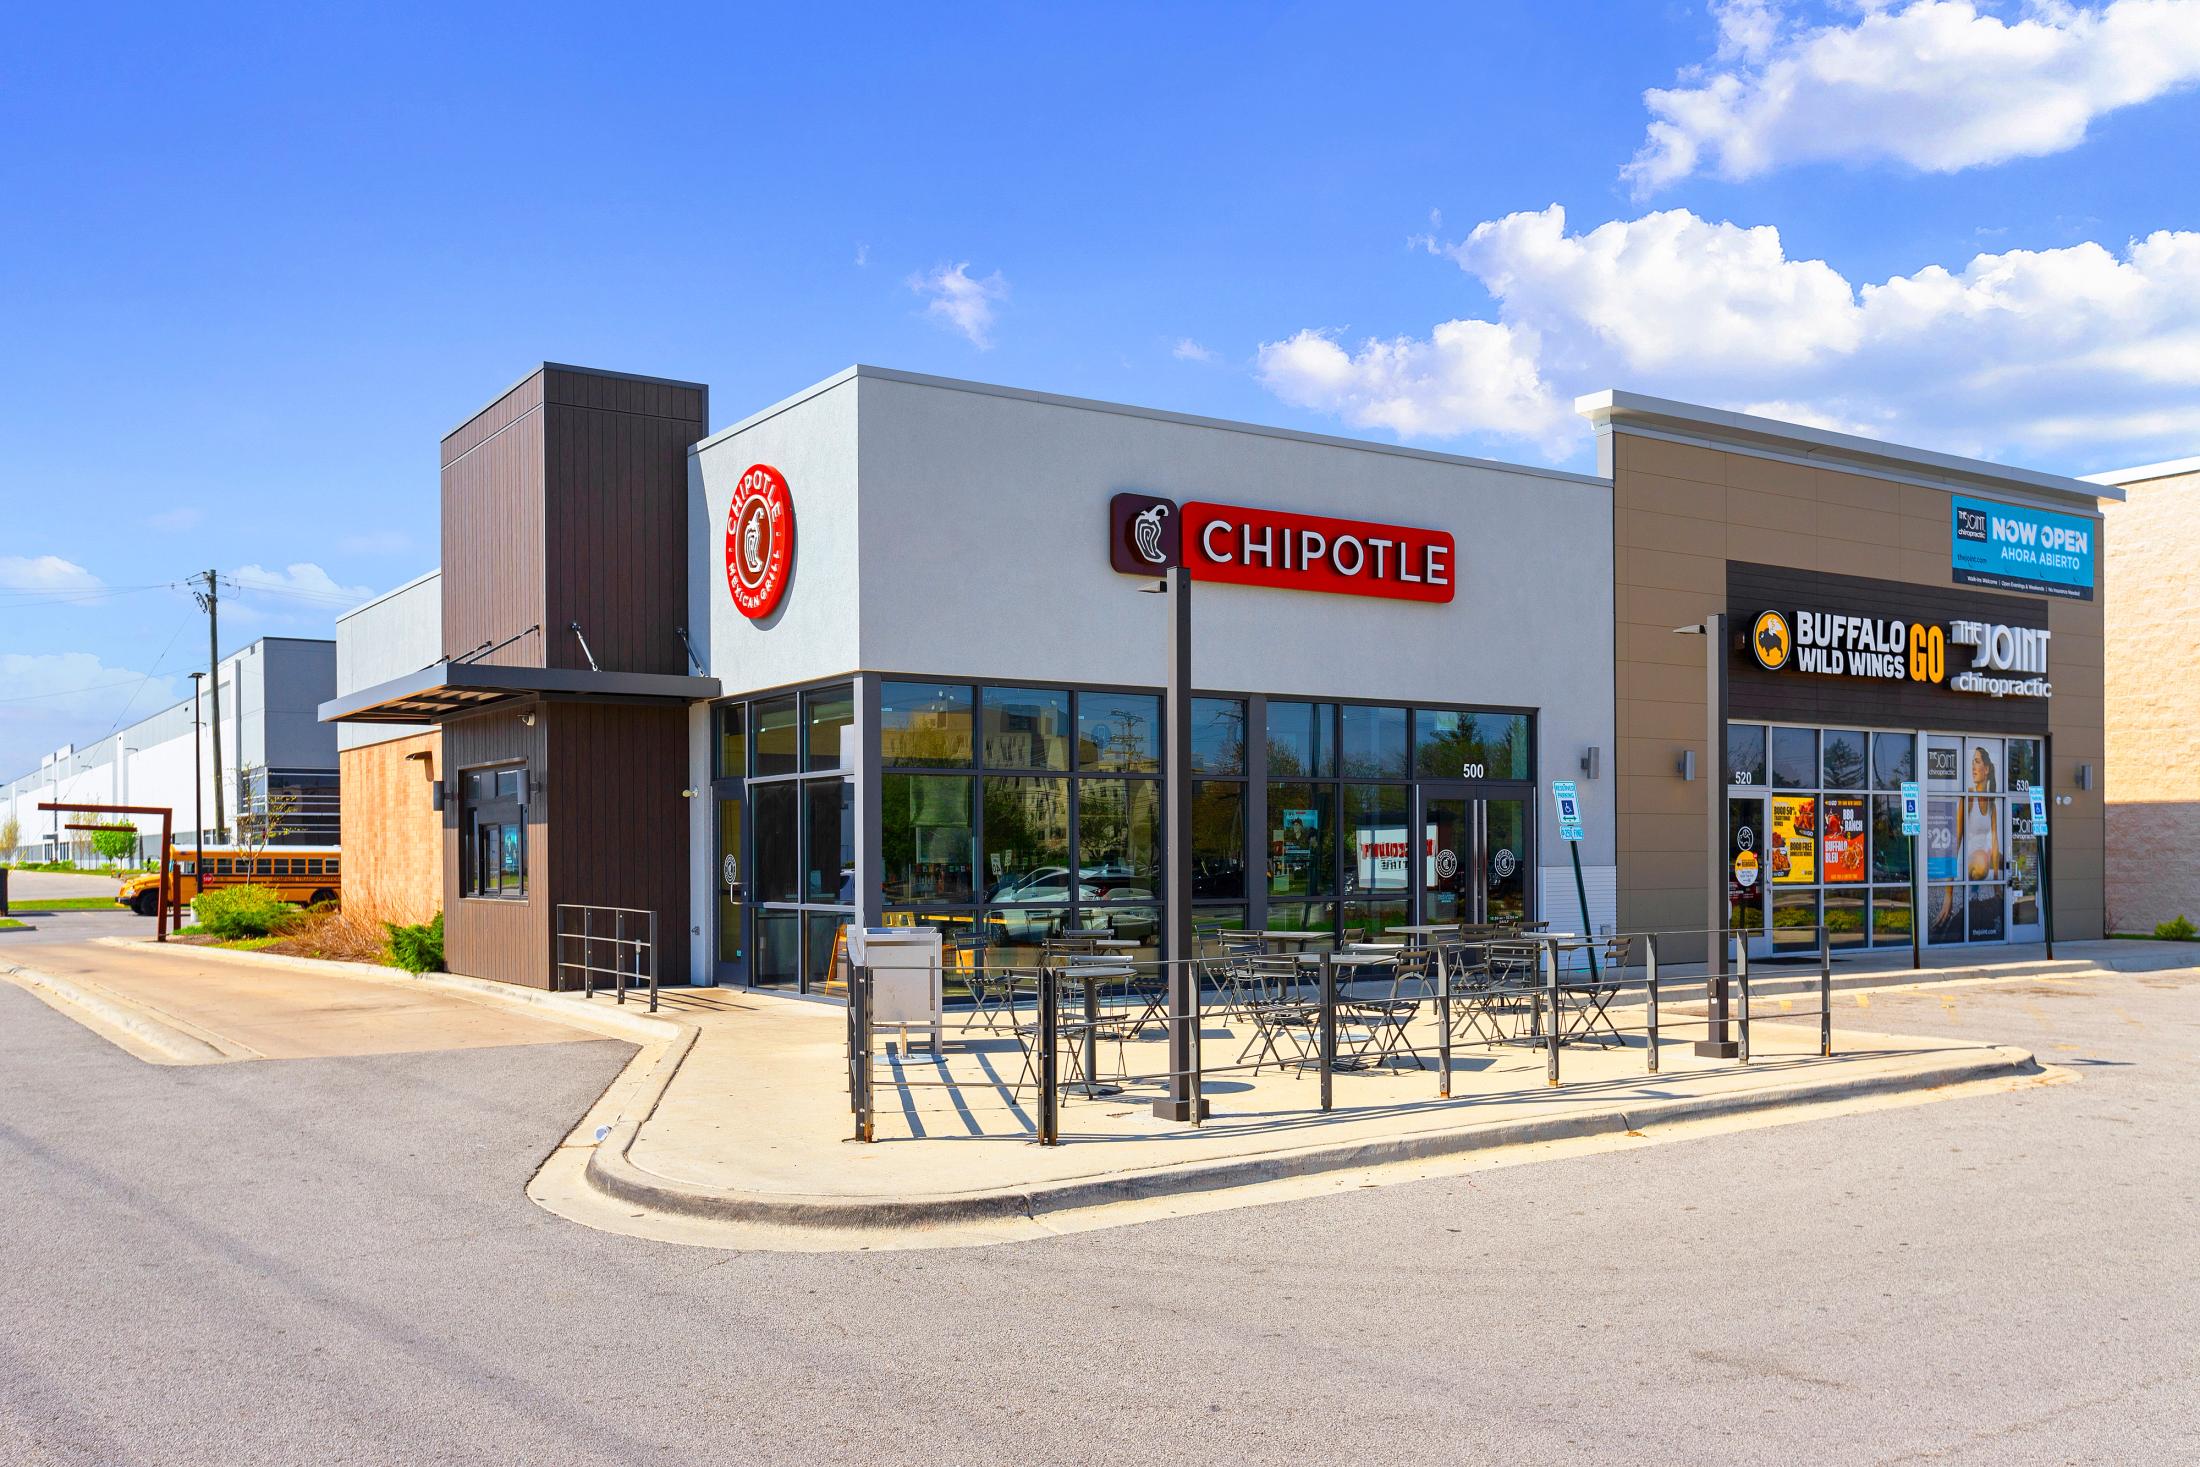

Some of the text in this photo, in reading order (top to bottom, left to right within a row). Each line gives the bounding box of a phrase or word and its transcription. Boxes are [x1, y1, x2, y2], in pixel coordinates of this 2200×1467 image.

[727, 470, 782, 536] CHIPOTLE
[1992, 516, 2088, 555] NOW OPEN
[1203, 520, 1448, 585] CHIPOTLE
[2001, 546, 2080, 570] AHORA ABIERTO
[1796, 610, 1906, 653] BUFFALO
[1910, 623, 1945, 684] GO
[1953, 620, 2050, 673] THE JOINT
[1797, 646, 1905, 680] WILD WINGS
[1958, 671, 2052, 698] chiropractic
[1463, 763, 1484, 779] 500
[1736, 772, 1752, 784] 520
[2016, 780, 2029, 791] 530
[1843, 809, 1854, 820] BBQ
[1845, 820, 1863, 832] RANCH
[1825, 841, 1848, 852] BUFFALO
[1928, 827, 1952, 849] $29
[1825, 852, 1838, 864] BLEU
